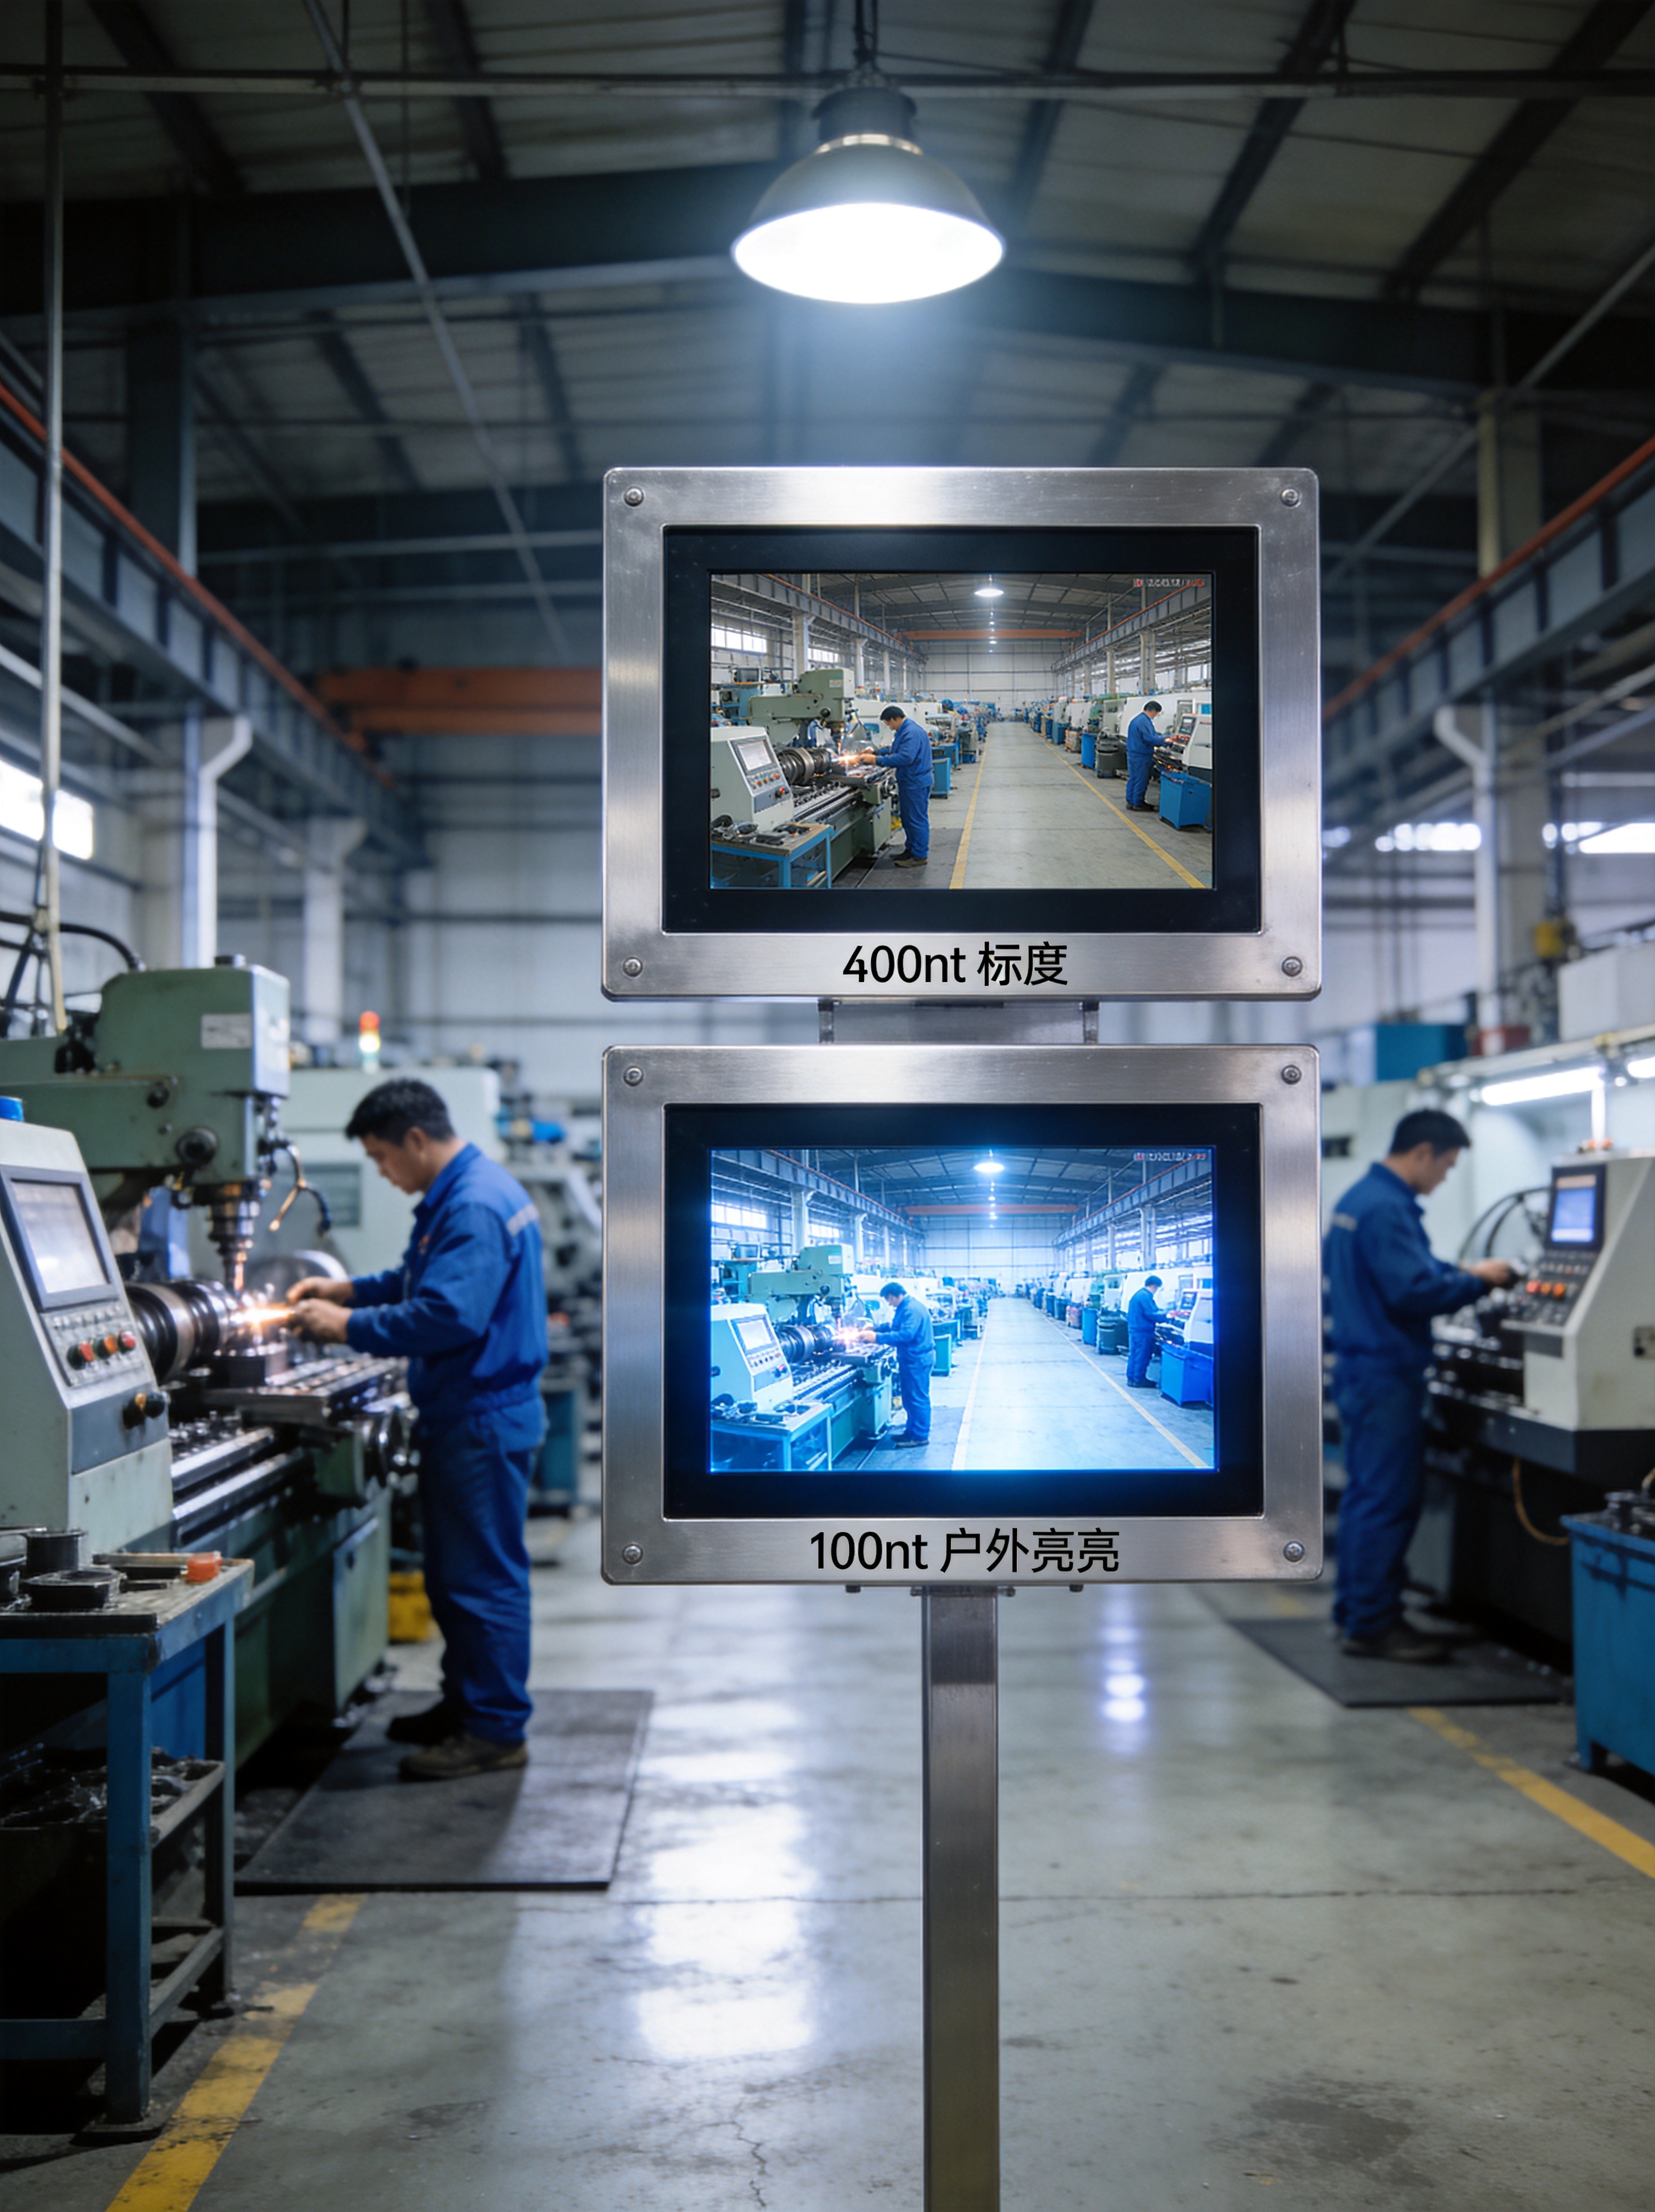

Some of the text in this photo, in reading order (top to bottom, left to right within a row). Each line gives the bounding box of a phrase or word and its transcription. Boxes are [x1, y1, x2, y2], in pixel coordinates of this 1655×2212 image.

[843, 941, 1068, 987] 400nt 标度
[811, 1527, 1120, 1573] 100nt 户外亮亮
